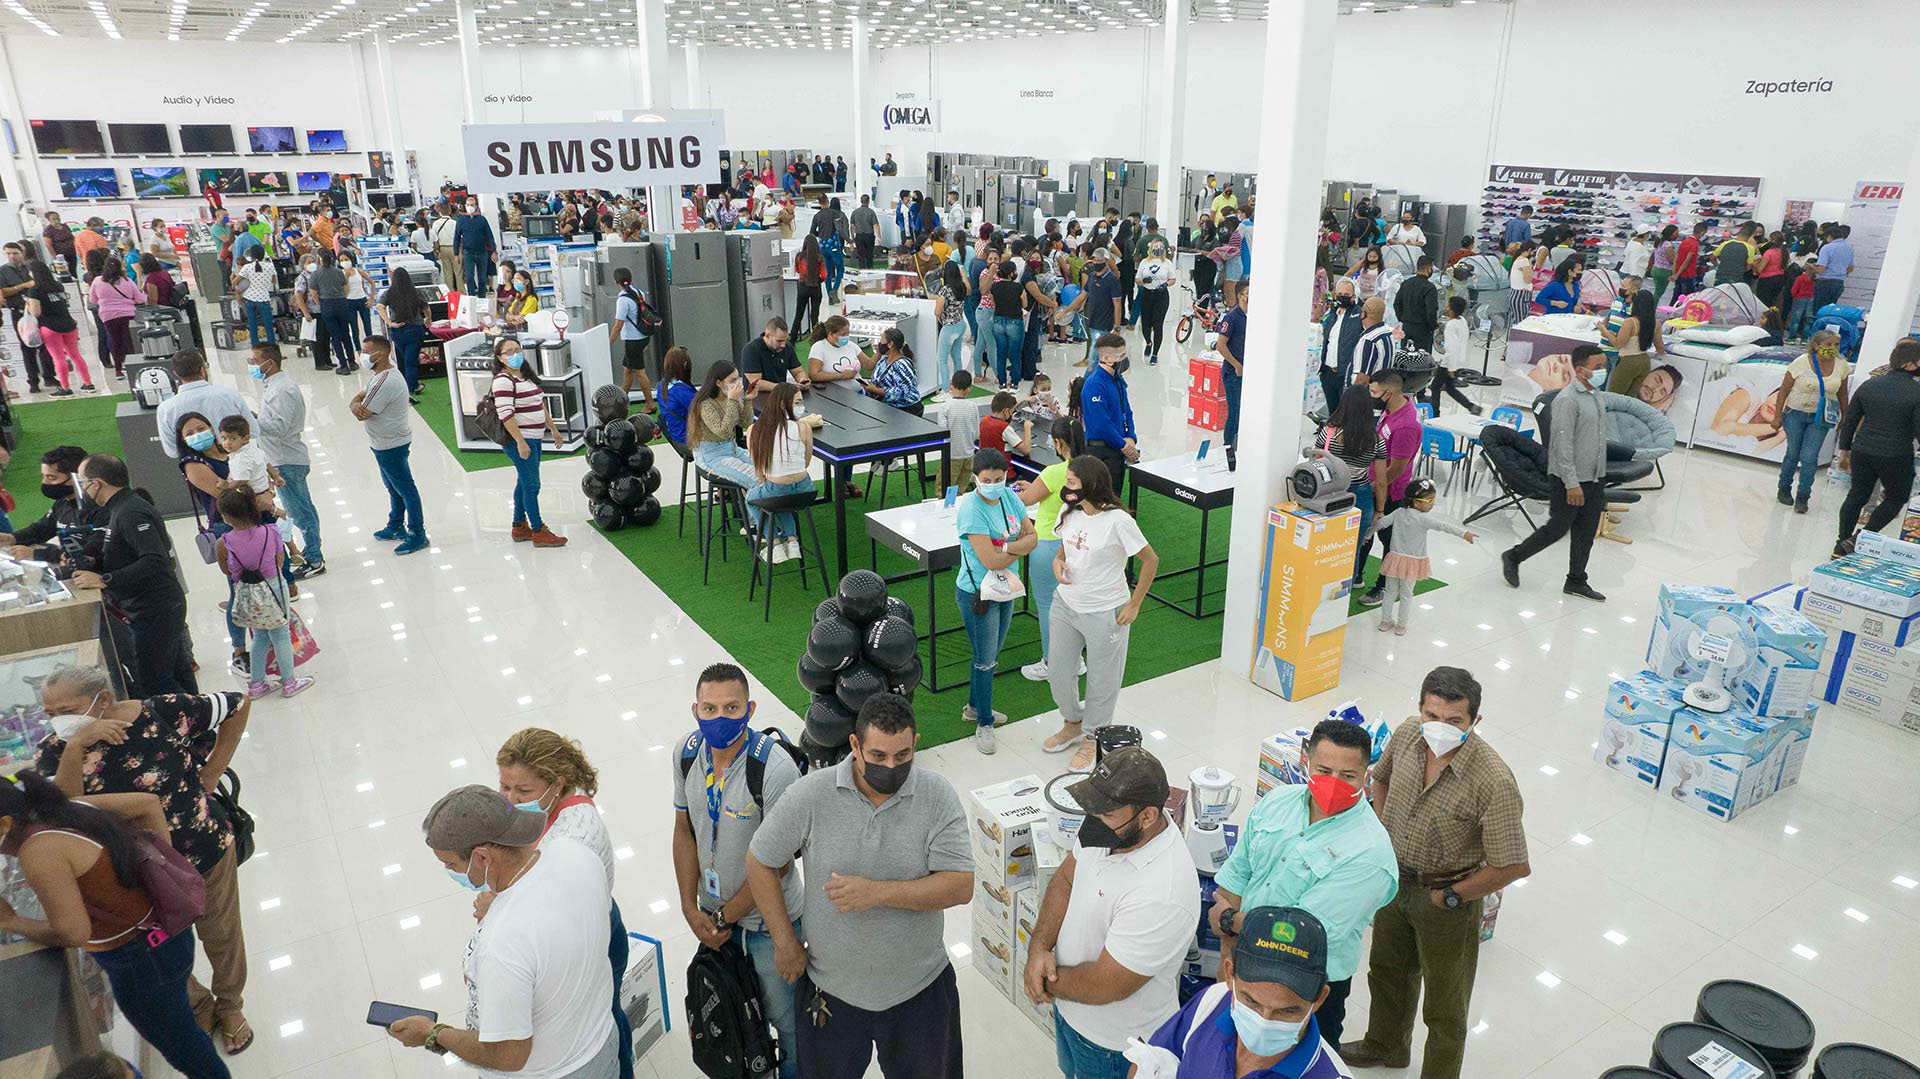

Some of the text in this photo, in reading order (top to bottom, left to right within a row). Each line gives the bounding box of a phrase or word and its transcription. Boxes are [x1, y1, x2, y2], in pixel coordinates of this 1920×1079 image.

[1745, 77, 1833, 97] Zapatería
[162, 95, 235, 108] Audio y Video
[484, 94, 533, 104] dio y Video
[888, 106, 931, 125] OMEGA
[487, 135, 701, 178] SAMSUNG
[1174, 487, 1197, 503] Galaxy
[901, 542, 921, 560] Galaxy
[1809, 598, 1840, 613] ROYAL
[1861, 640, 1895, 656] ROYAL
[1854, 665, 1886, 680] ROYAL
[1847, 689, 1879, 705] ROYAL
[1256, 938, 1310, 959] JOHN DEERE
